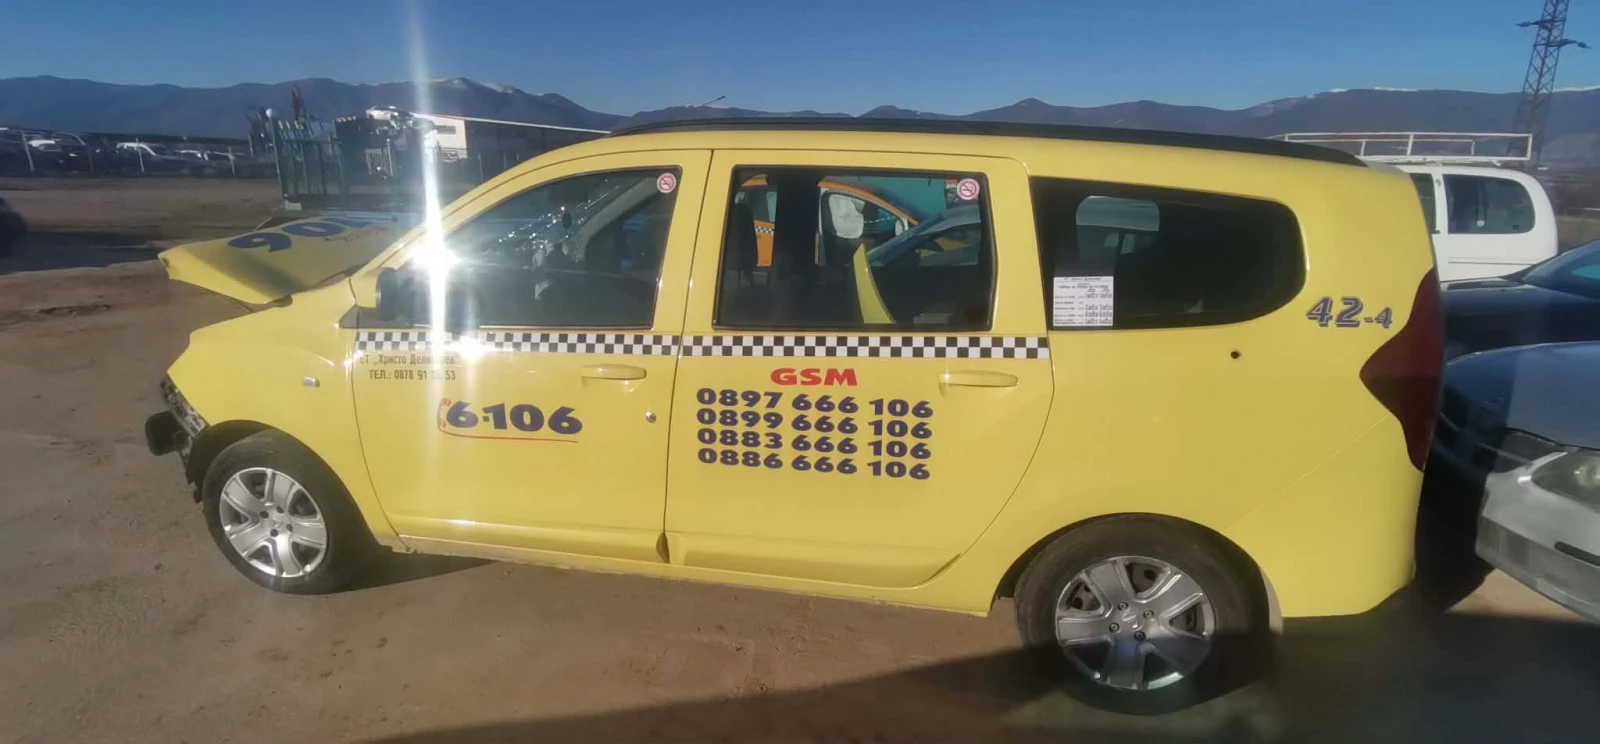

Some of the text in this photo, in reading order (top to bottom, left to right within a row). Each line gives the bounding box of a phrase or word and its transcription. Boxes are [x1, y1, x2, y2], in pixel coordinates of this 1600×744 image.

[1306, 296, 1393, 329] 42-4
[770, 368, 858, 387] GSM
[446, 401, 583, 434] 6-106
[696, 388, 933, 418] 0897 666 106
[696, 408, 933, 439] 0899 666 106
[697, 428, 931, 460] 0883 666 106
[697, 447, 931, 480] 0886 666 106
